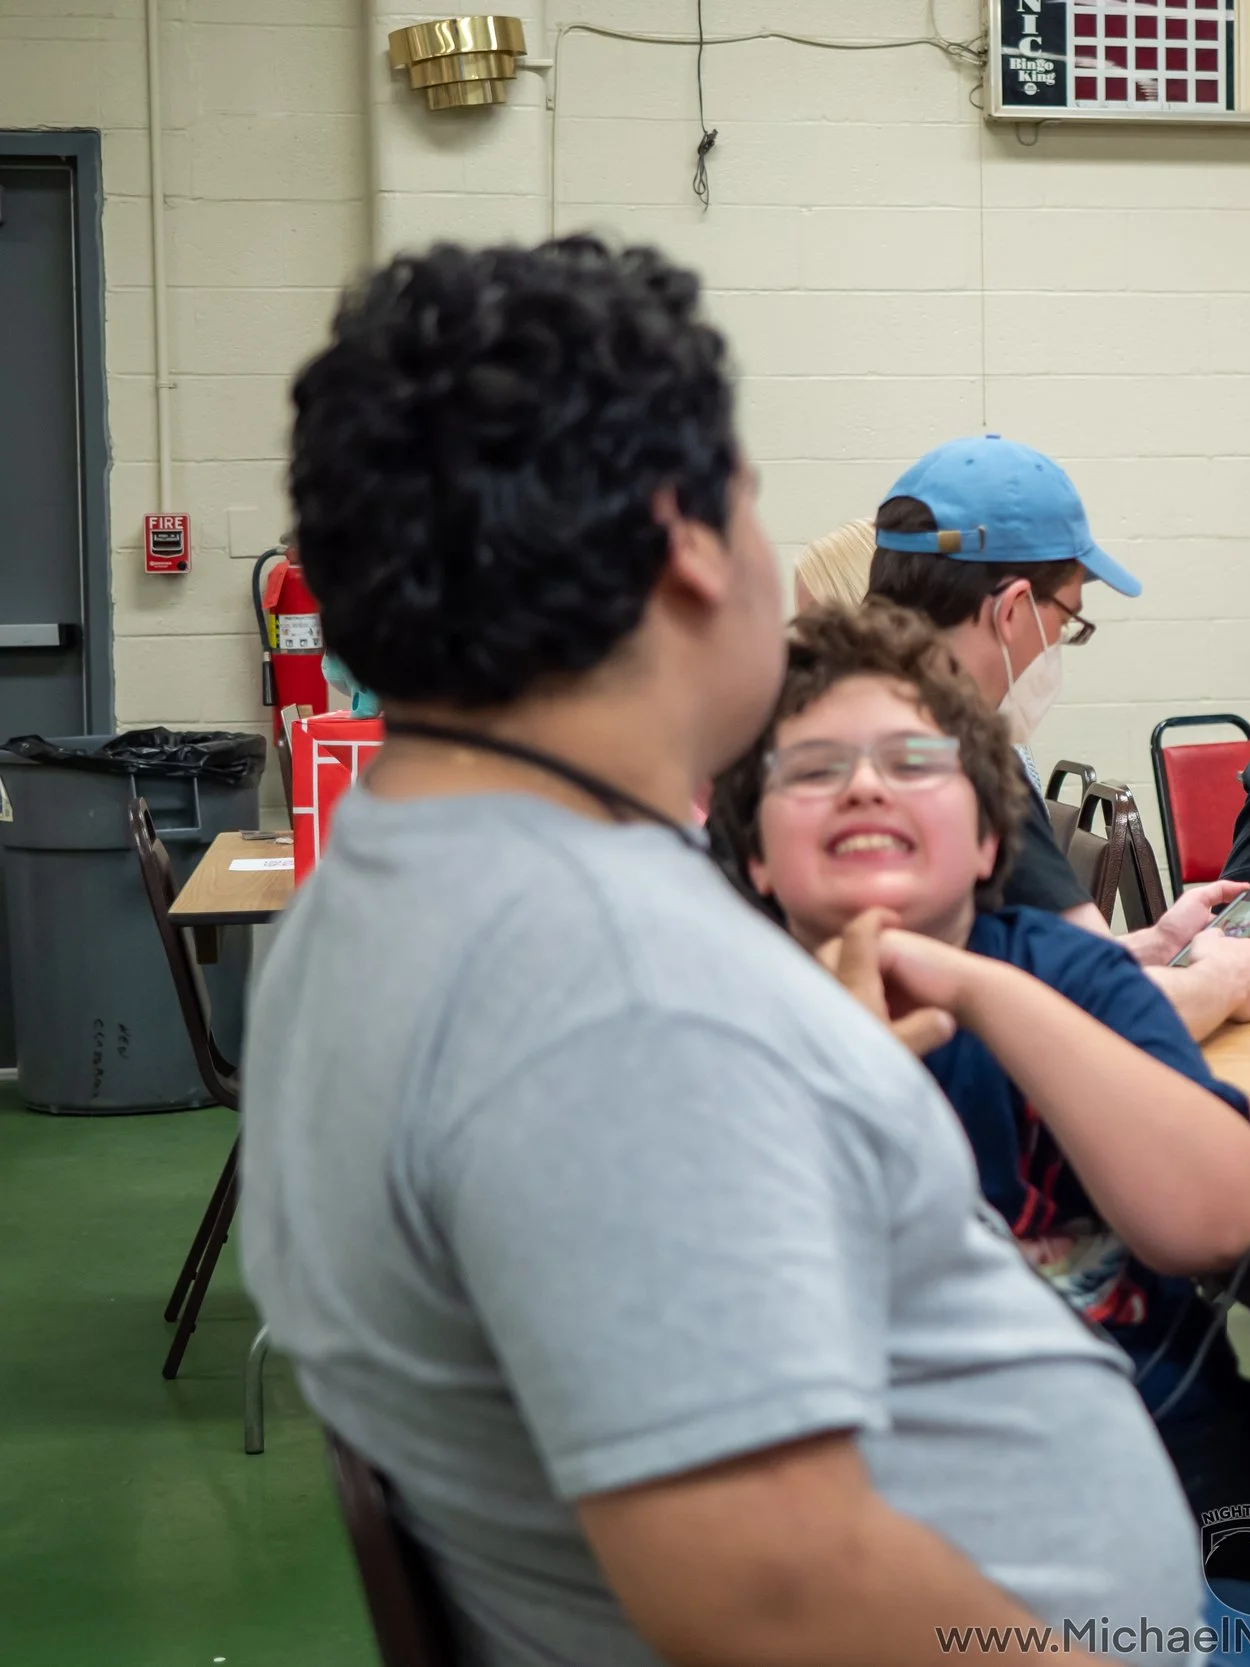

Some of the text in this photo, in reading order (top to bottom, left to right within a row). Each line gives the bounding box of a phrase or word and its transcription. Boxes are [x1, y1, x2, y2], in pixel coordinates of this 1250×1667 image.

[1009, 57, 1054, 73] Bingo
[1018, 70, 1056, 86] King
[149, 516, 184, 529] FIRE
